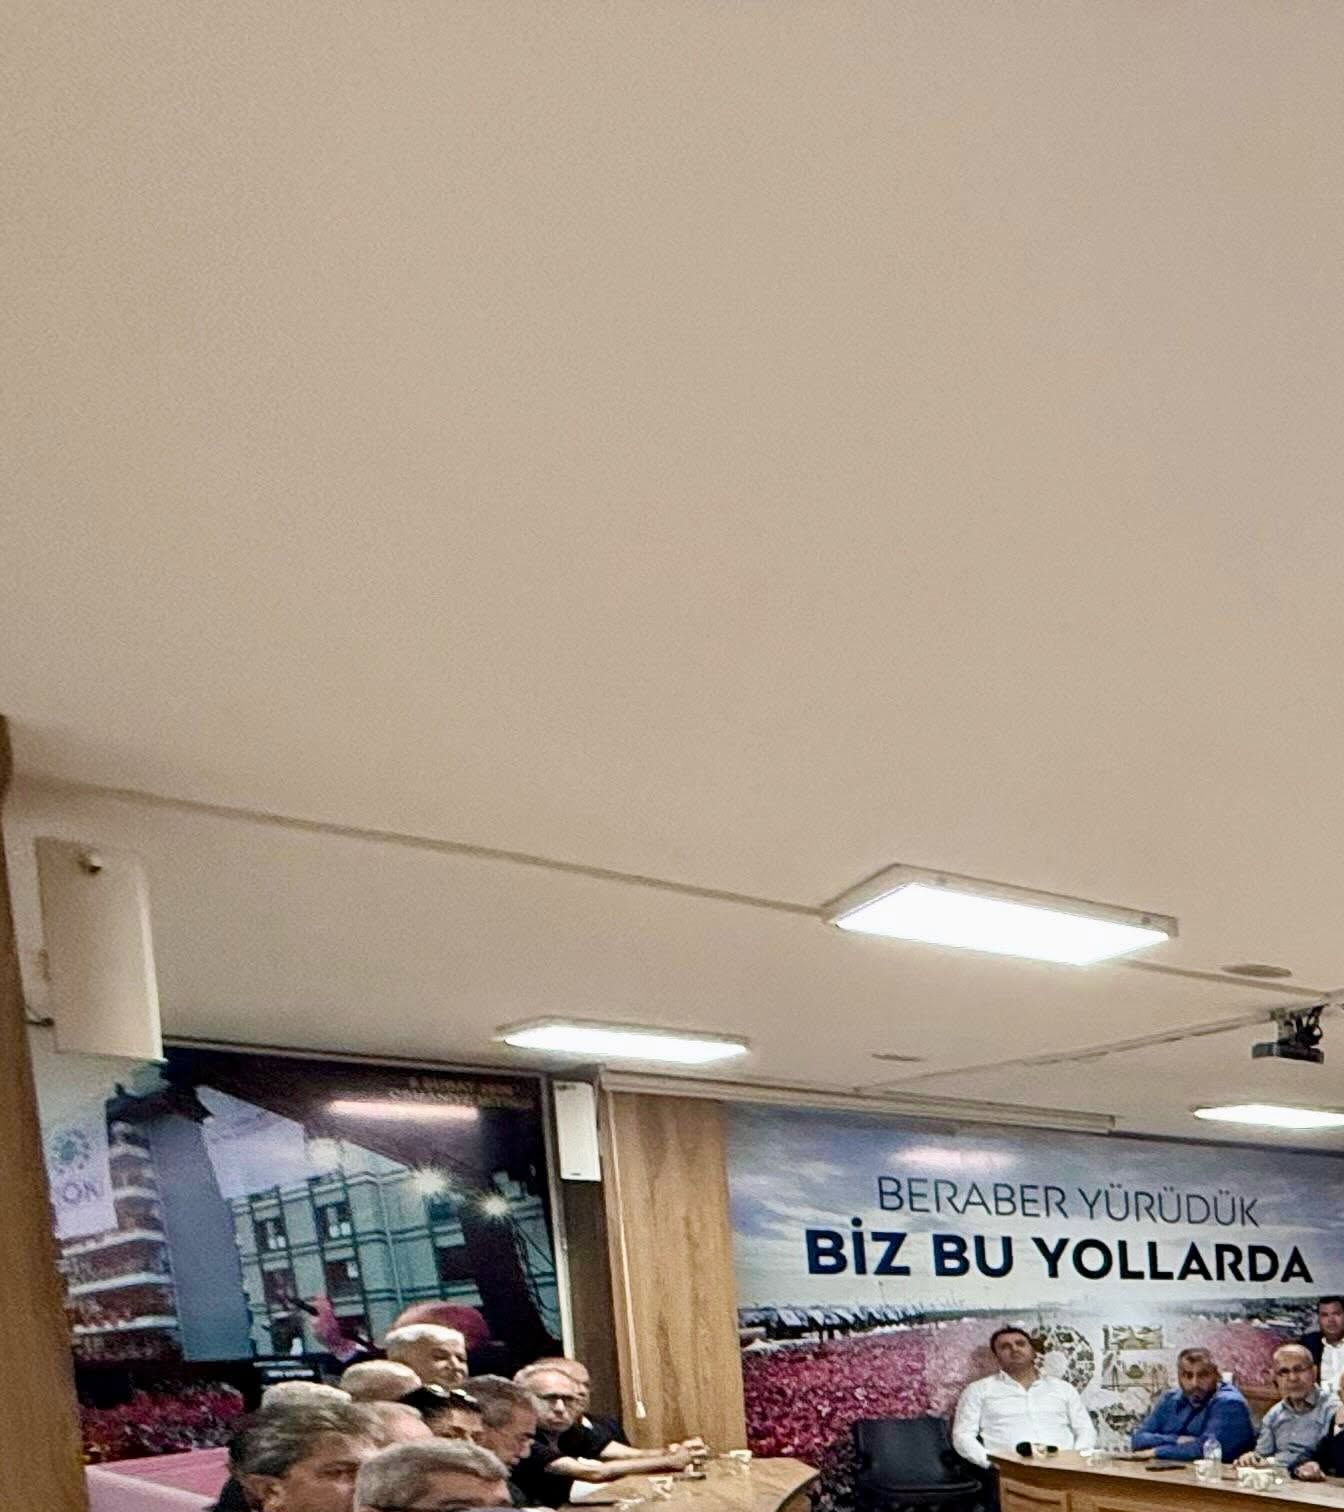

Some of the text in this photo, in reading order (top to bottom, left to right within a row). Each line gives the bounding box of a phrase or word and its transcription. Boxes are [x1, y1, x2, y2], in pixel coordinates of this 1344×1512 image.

[878, 1176, 1258, 1228] BERABER YÜRÜDÜK
[805, 1217, 1314, 1285] BİZ BU YOLLARDA
